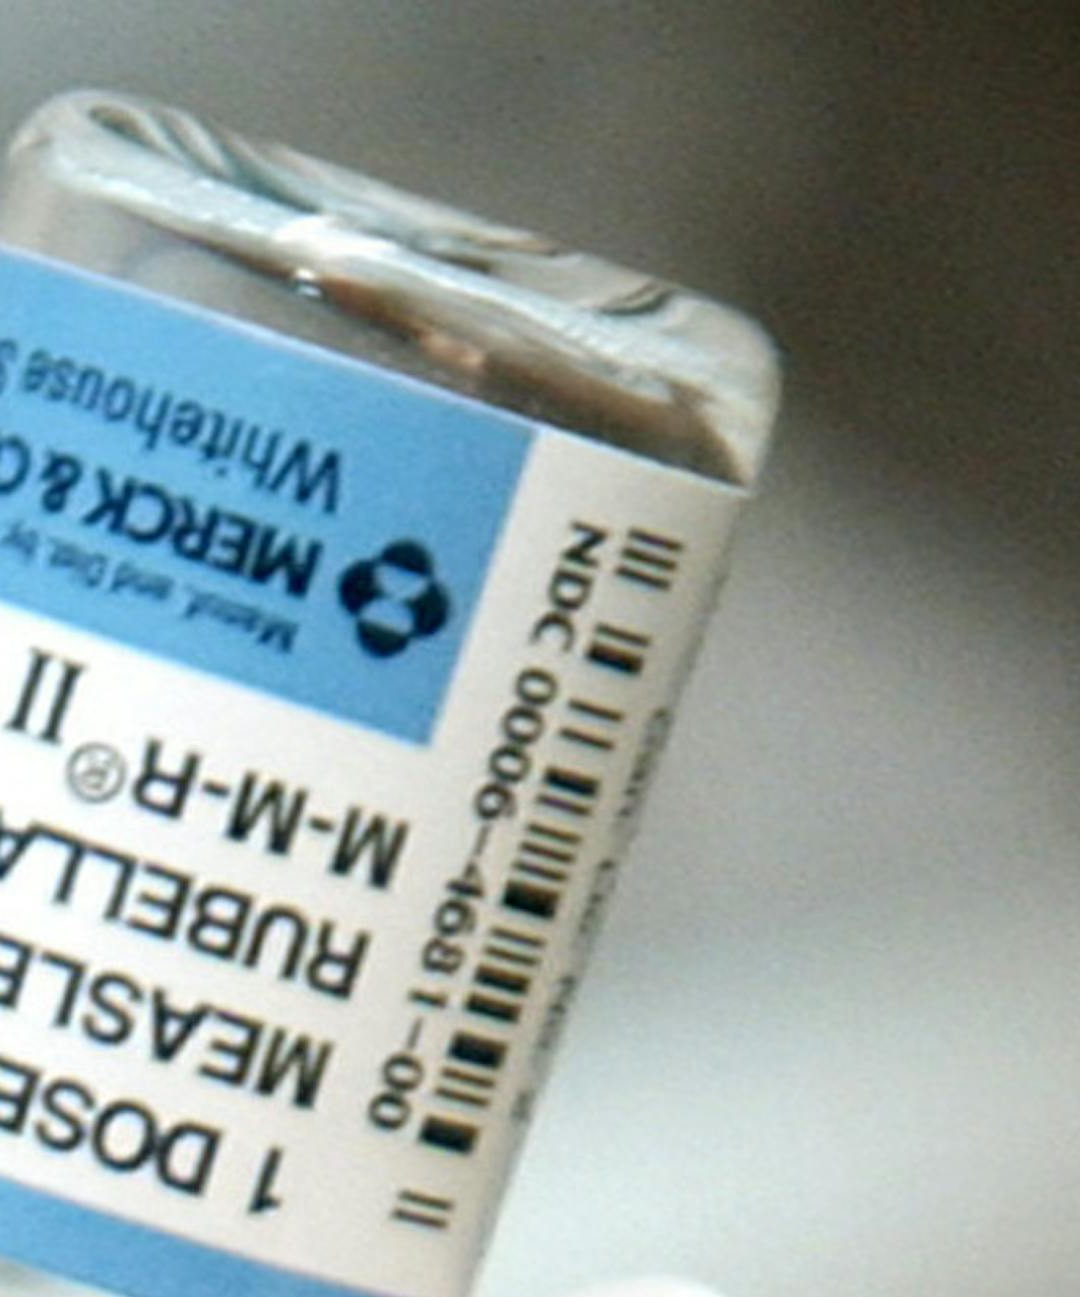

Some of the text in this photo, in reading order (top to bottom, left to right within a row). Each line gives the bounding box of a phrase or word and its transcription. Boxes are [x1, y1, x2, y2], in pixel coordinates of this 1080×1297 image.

[23, 348, 341, 514] Whitehouse
[40, 449, 84, 514] &
[83, 471, 325, 599] MERCK
[529, 520, 608, 653] NDC
[5, 647, 85, 746] II
[368, 668, 559, 1131] 0006-4681-00
[248, 1146, 284, 1215] 1
